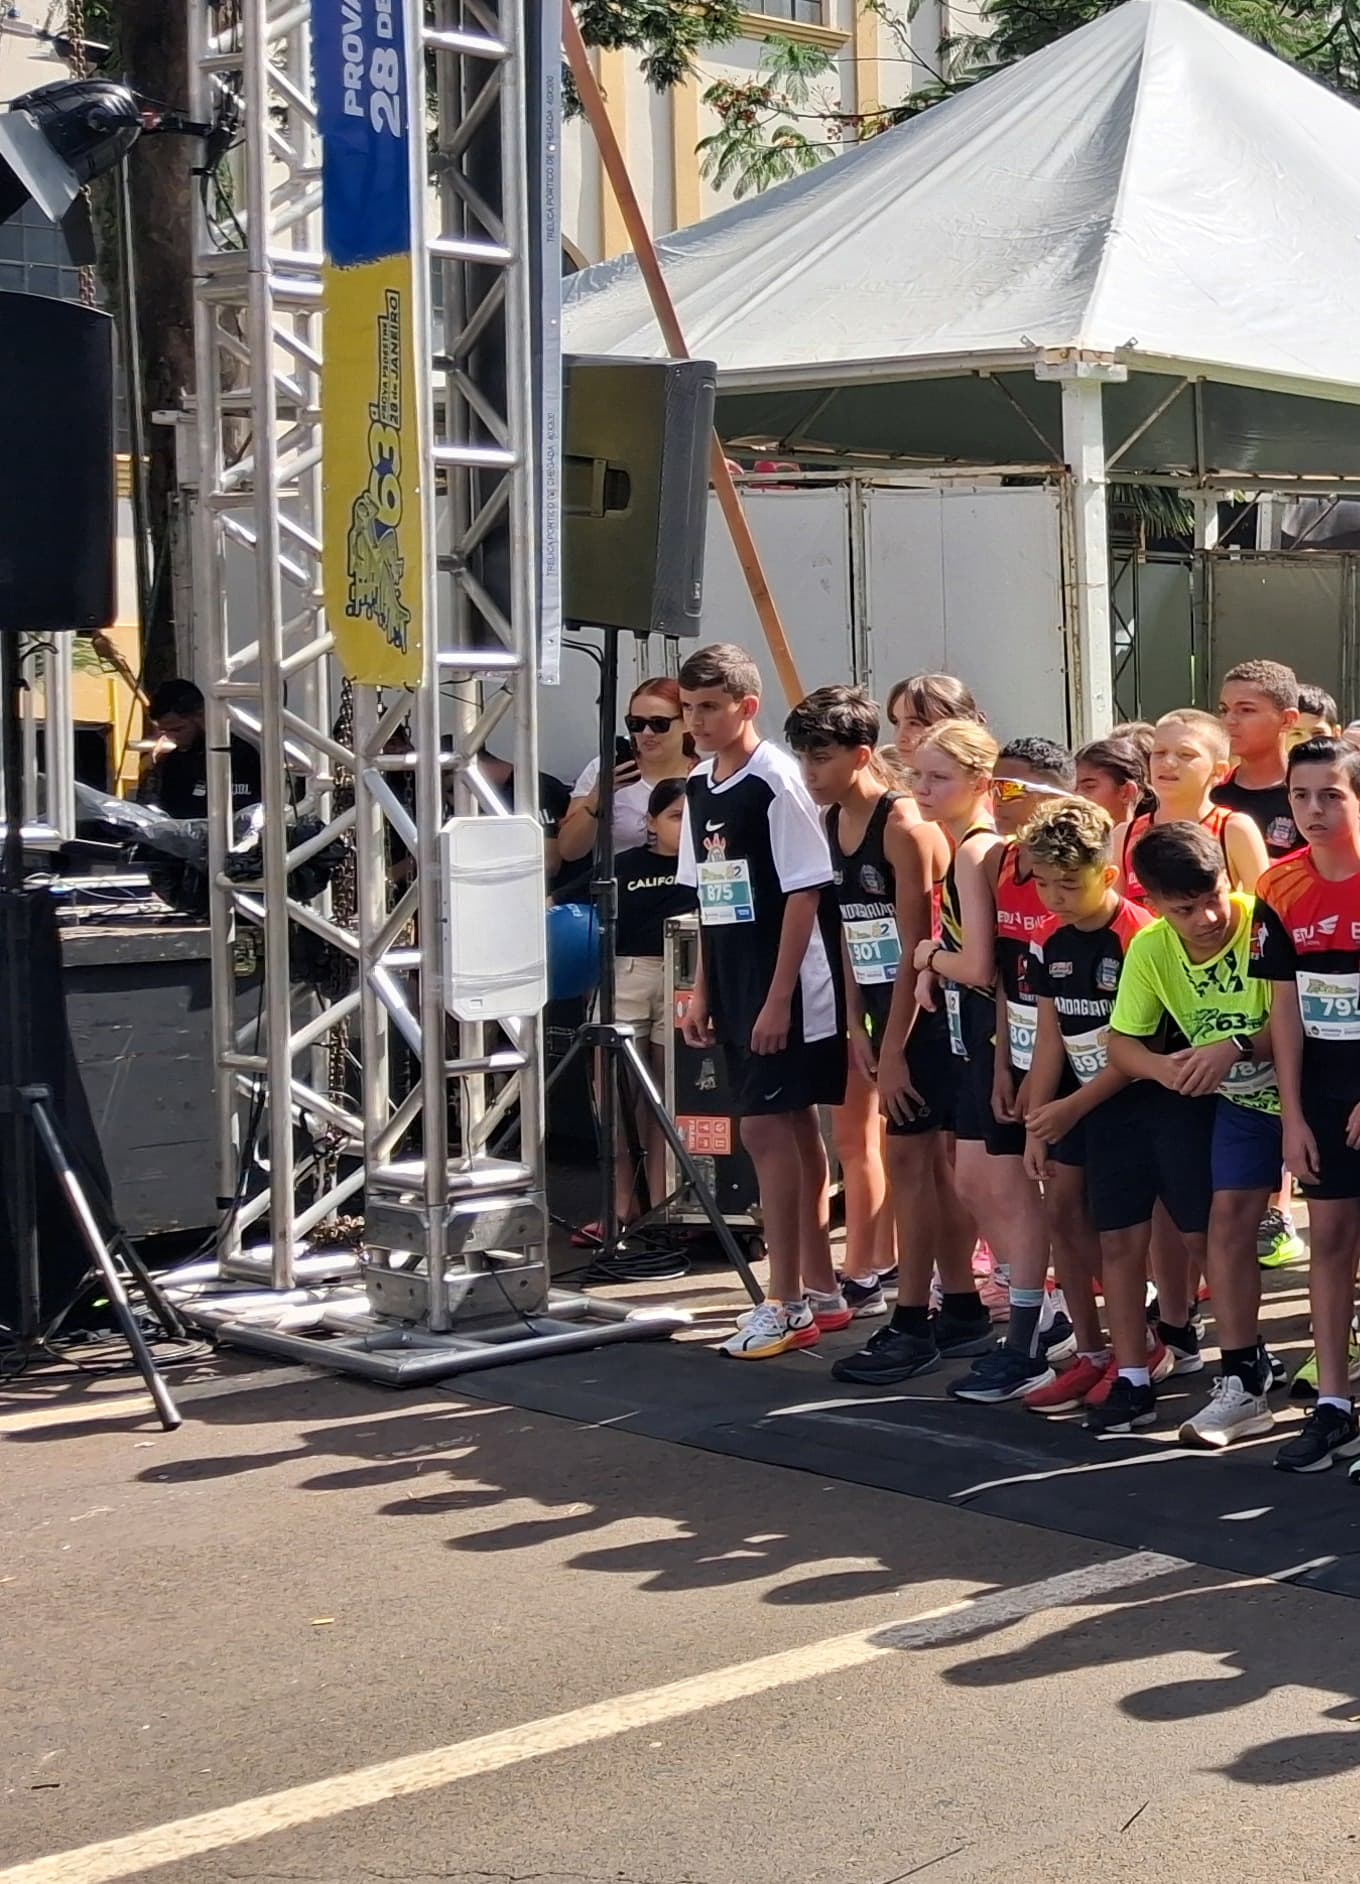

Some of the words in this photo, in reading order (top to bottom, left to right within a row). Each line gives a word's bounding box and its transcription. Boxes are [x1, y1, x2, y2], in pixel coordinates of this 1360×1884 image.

[370, 47, 401, 138] 28
[387, 296, 399, 380] JANEIRO
[389, 403, 400, 426] 28
[1216, 1012, 1248, 1031] 63
[1010, 1026, 1037, 1048] 80
